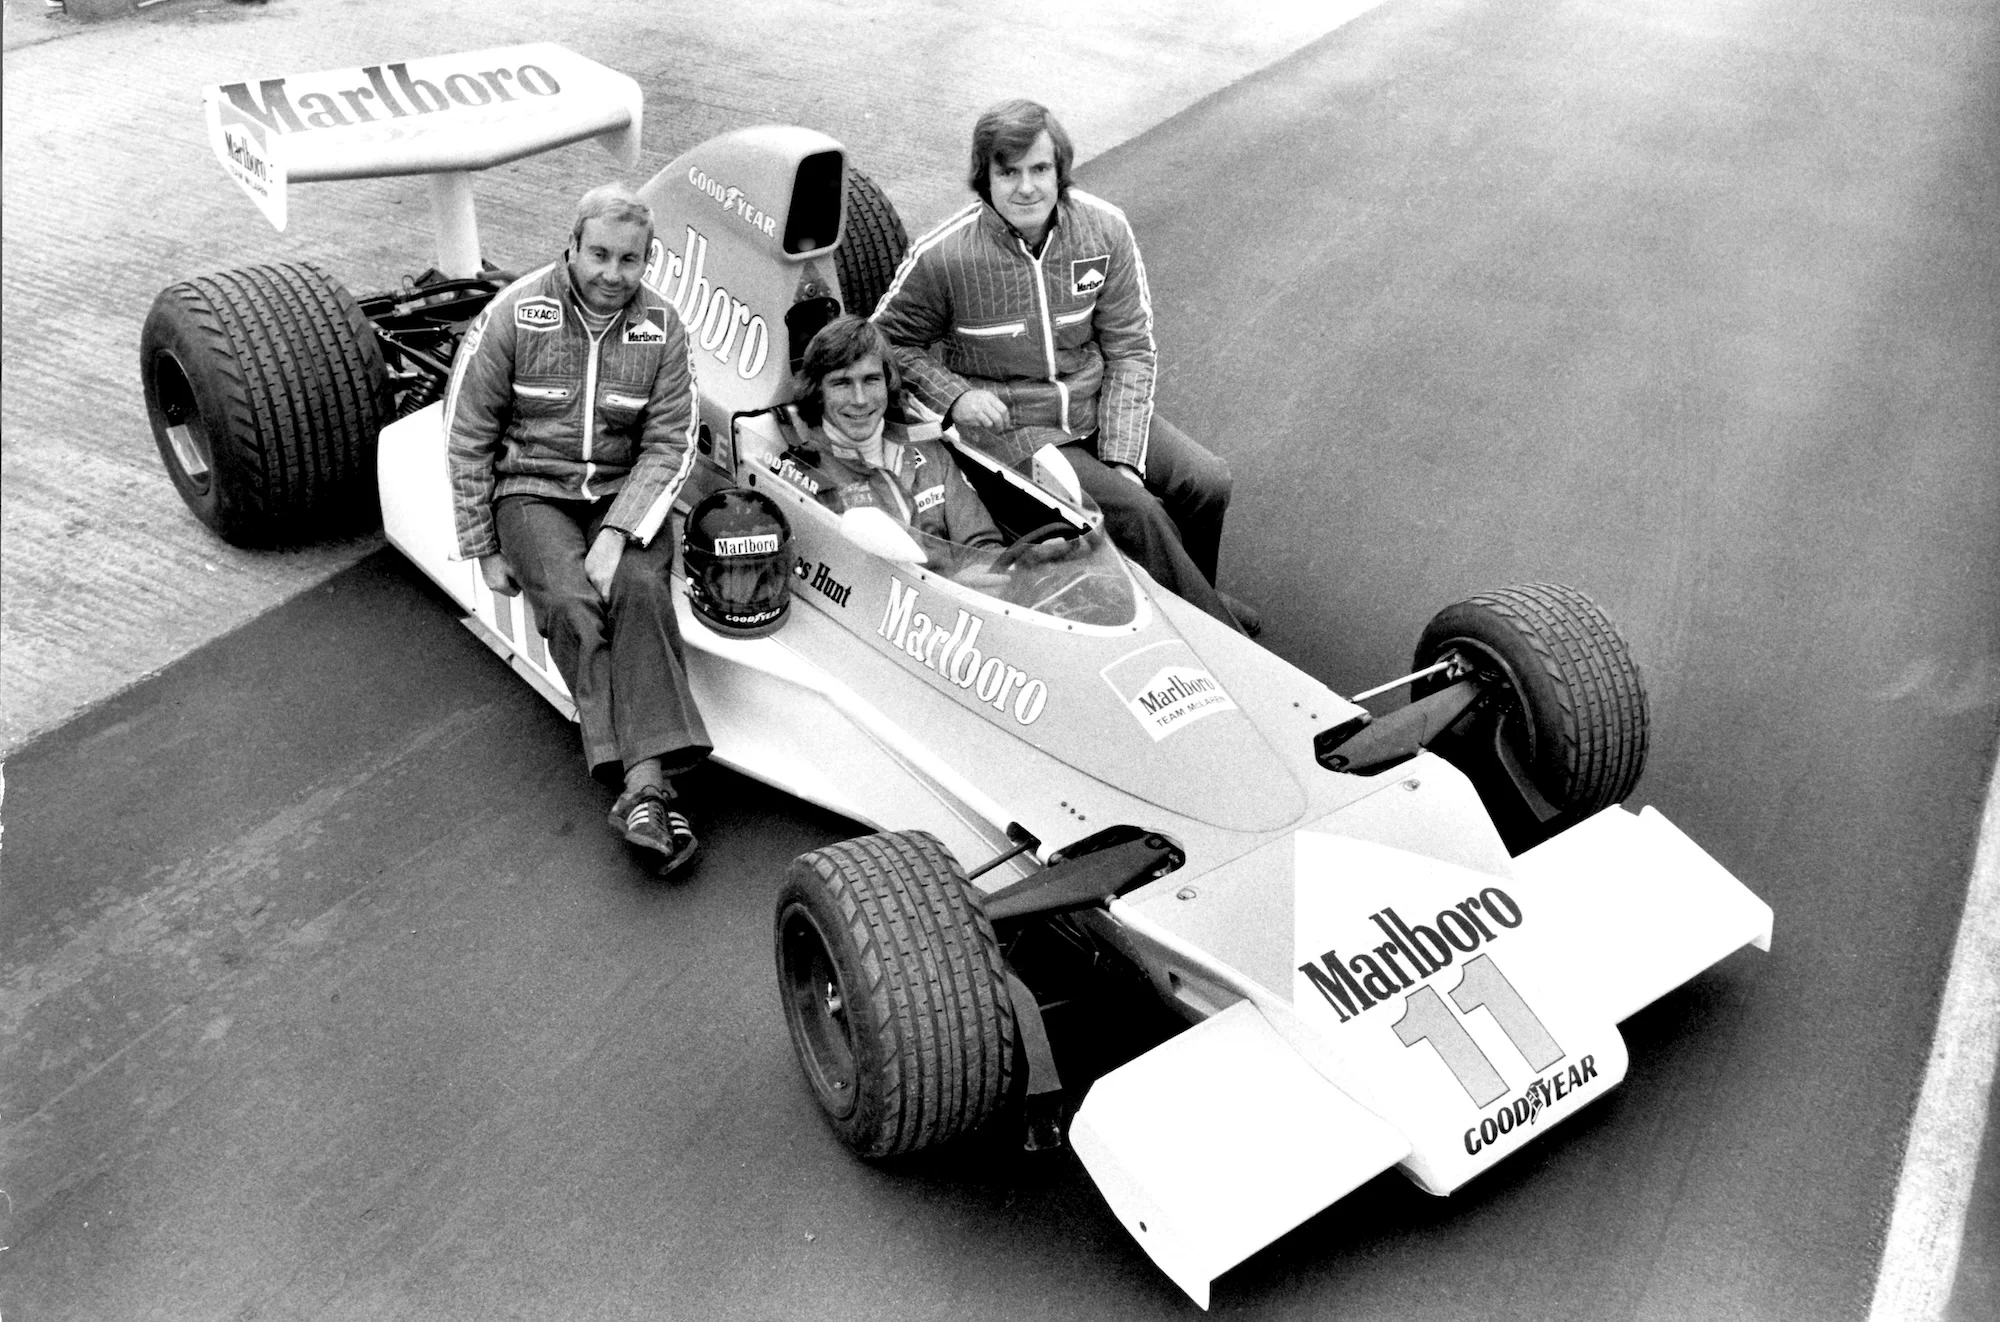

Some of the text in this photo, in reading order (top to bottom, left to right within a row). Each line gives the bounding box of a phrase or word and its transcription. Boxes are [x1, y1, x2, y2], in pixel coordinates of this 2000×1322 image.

[219, 62, 561, 135] Marlboro
[225, 130, 266, 182] Marlboro
[688, 166, 776, 238] GOODYEAR
[521, 308, 558, 320] TEXACO
[643, 224, 769, 380] arlboro
[628, 331, 663, 342] Marlboro
[718, 539, 775, 556] Marlboro
[810, 561, 852, 608] Hunt
[877, 574, 1049, 726] Marlboro
[1138, 674, 1216, 716] Marlboro
[1156, 708, 1186, 727] TEAM
[1298, 887, 1523, 1024] Marlboro
[1391, 953, 1566, 1110] 11
[1463, 1054, 1598, 1156] GOODYEAR
